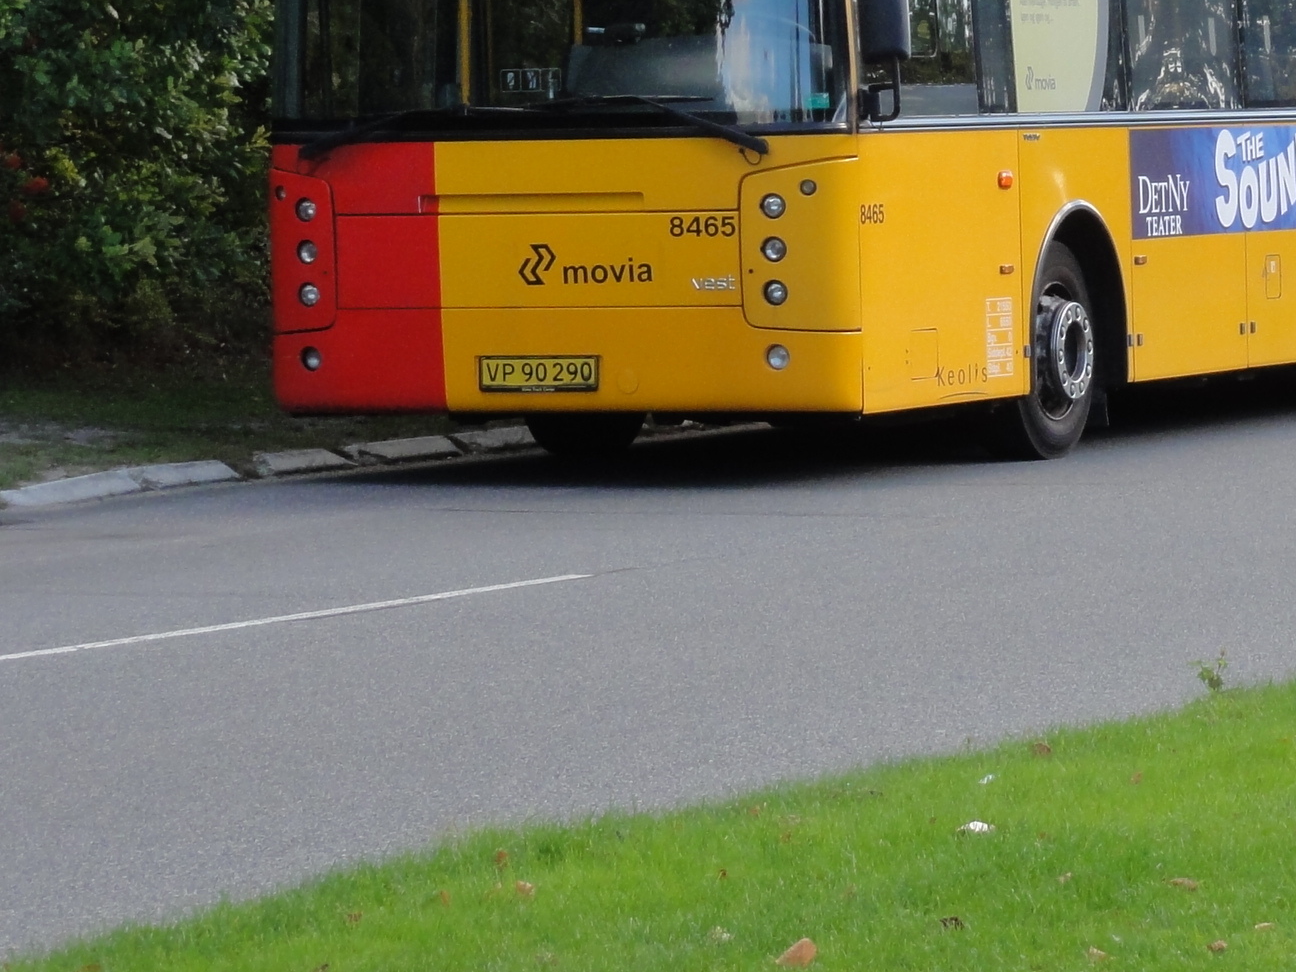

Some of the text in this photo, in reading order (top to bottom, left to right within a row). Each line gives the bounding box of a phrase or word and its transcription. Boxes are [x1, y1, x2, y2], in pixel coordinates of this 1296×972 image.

[1034, 74, 1057, 91] movia
[1236, 131, 1265, 162] THE
[860, 204, 885, 225] 8465
[668, 216, 737, 238] 8465
[1145, 215, 1183, 237] TEATER
[562, 256, 654, 285] movia
[690, 273, 737, 291] vest
[486, 362, 593, 383] VP 90 290
[937, 362, 989, 387] Keolis
